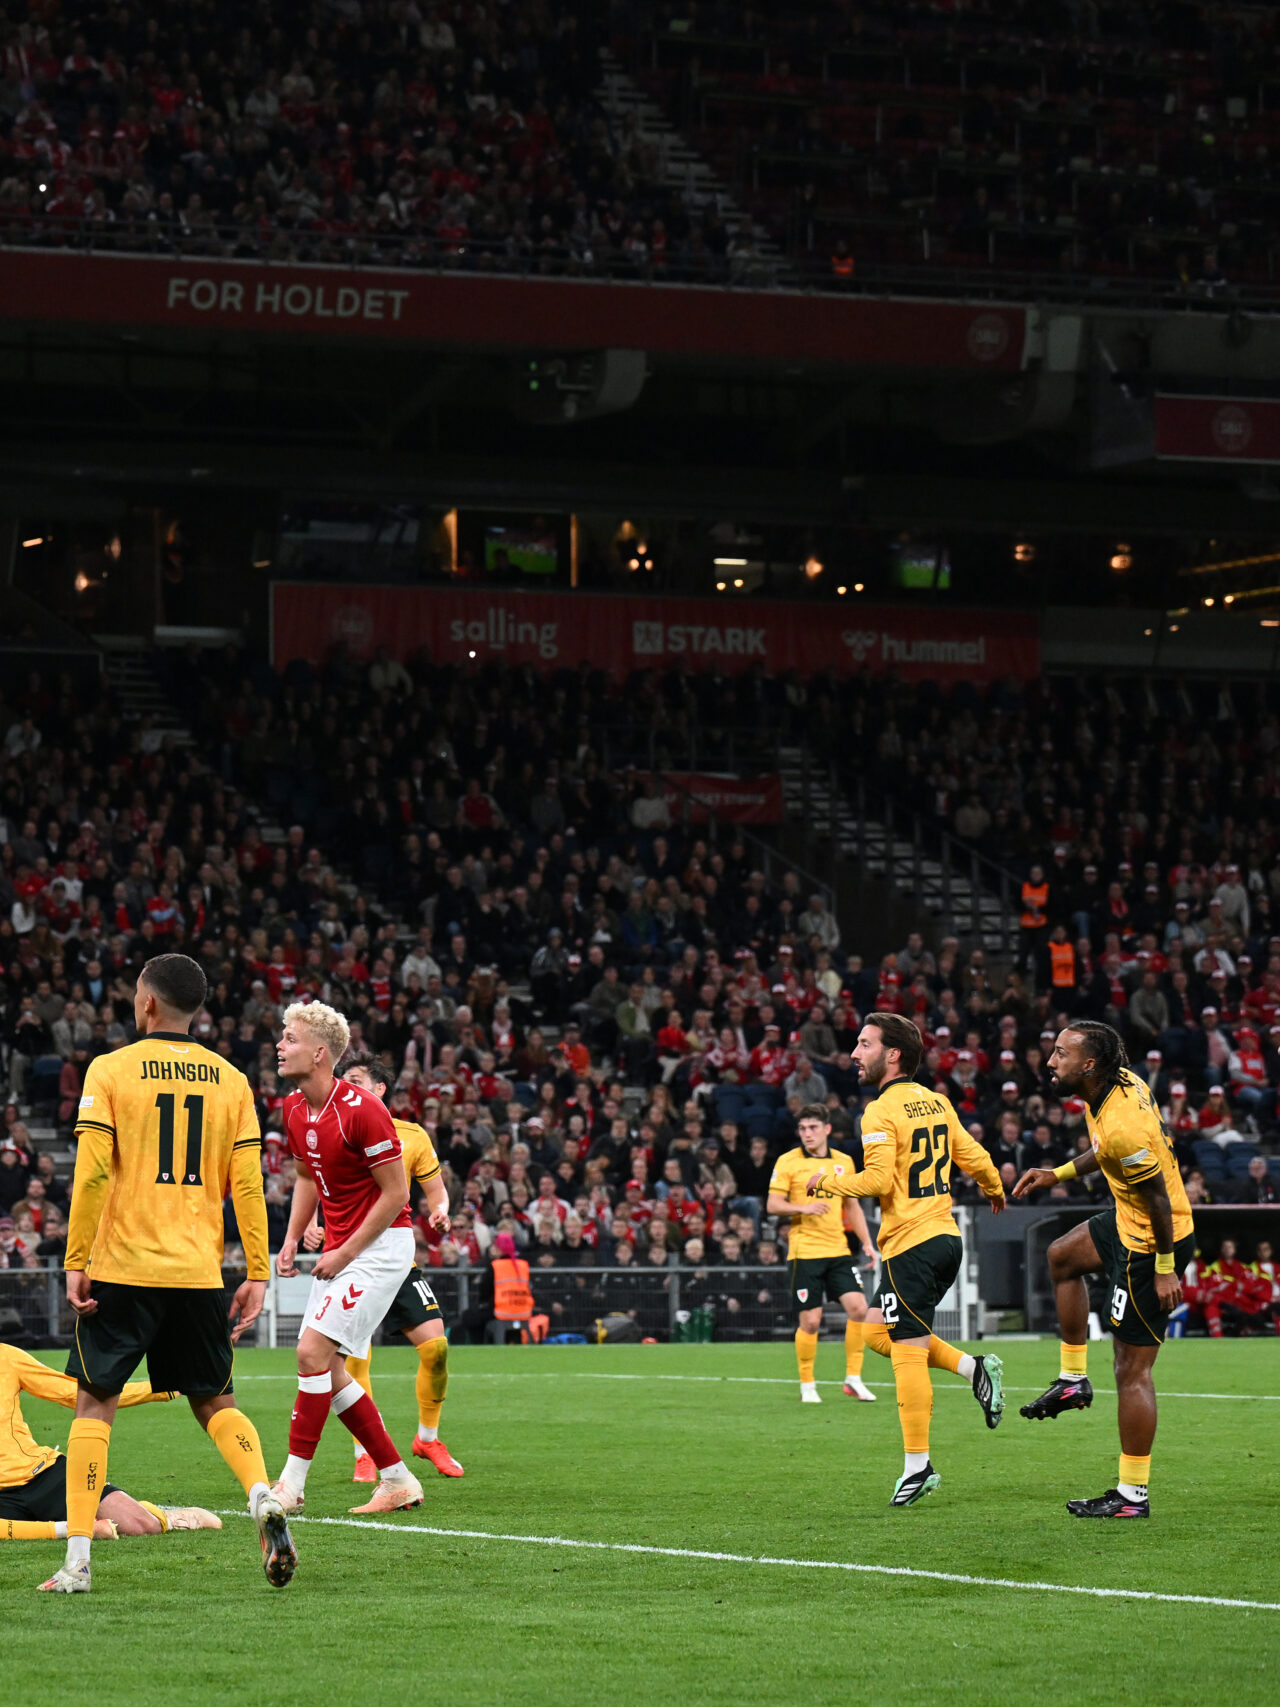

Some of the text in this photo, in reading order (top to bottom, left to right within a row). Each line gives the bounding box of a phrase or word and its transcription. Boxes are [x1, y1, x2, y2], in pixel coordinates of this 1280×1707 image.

[167, 278, 410, 320] FOR HOLDET
[450, 607, 558, 659] salling
[666, 624, 767, 655] STARK
[881, 632, 986, 664] hummel
[141, 1060, 220, 1085] JOHNSON
[155, 1093, 205, 1186] 11
[908, 1123, 950, 1199] 22
[315, 1295, 332, 1321] 3
[412, 1280, 438, 1306] 14
[87, 1462, 98, 1491] CYMRU
